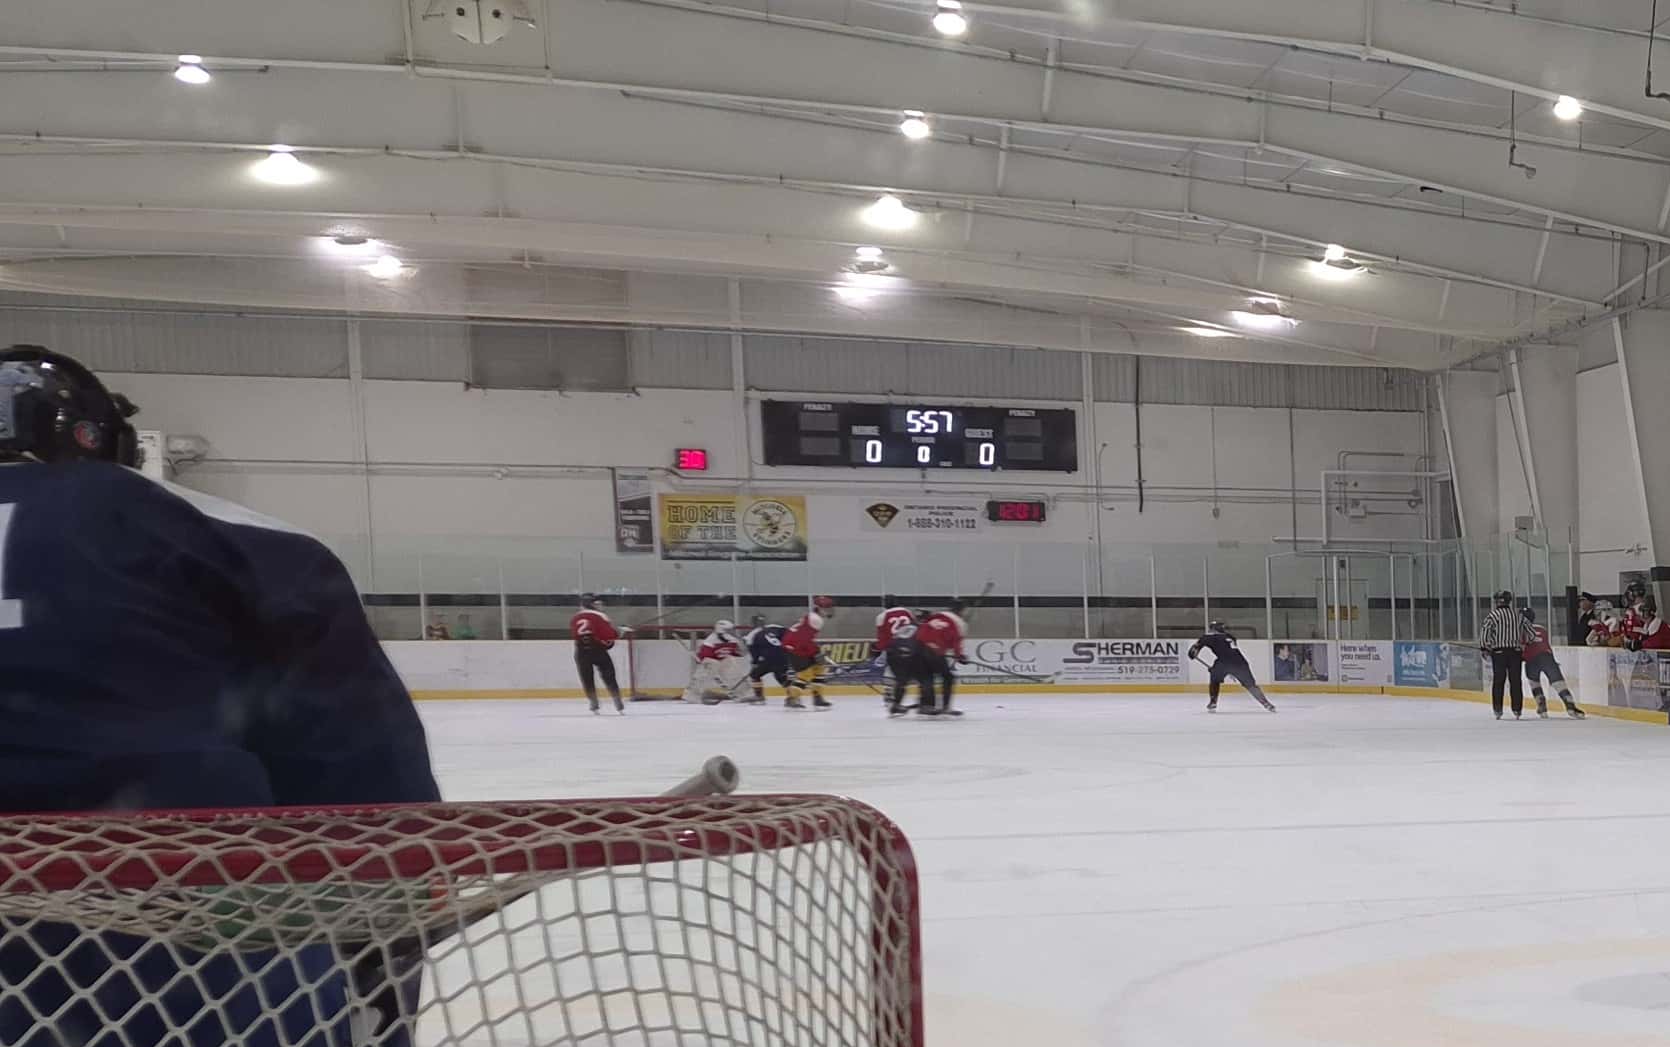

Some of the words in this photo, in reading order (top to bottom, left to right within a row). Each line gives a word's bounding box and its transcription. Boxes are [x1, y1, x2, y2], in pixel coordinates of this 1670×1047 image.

[906, 410, 953, 433] 5:57
[866, 439, 882, 463] 0
[917, 446, 931, 463] 0
[979, 443, 995, 466] 0
[668, 505, 736, 524] HOME
[697, 526, 736, 541] THE
[1062, 642, 1179, 665] SHERMAN
